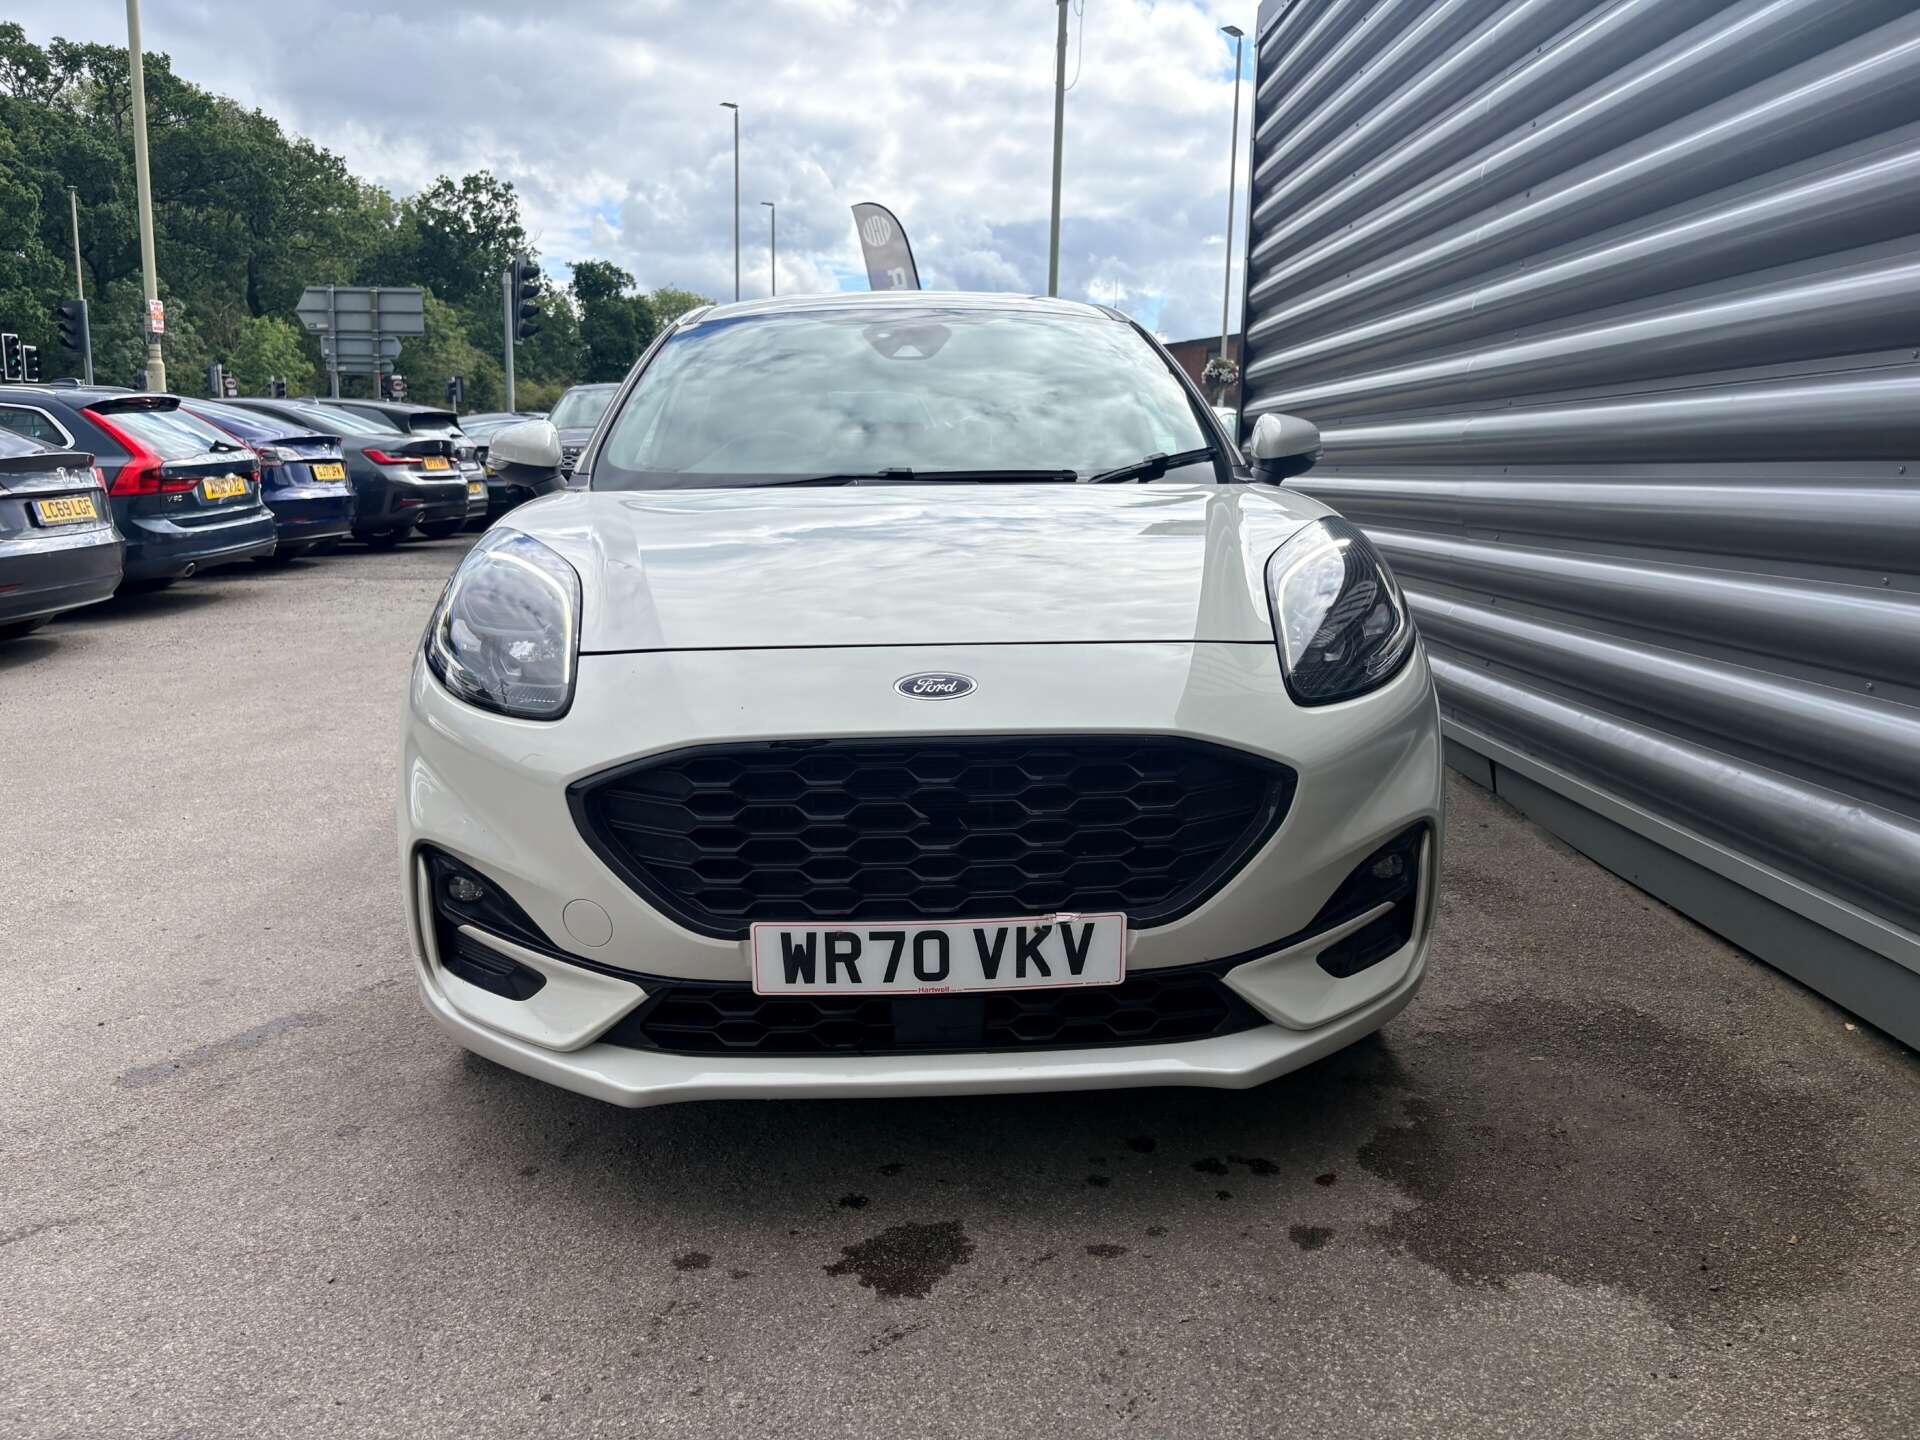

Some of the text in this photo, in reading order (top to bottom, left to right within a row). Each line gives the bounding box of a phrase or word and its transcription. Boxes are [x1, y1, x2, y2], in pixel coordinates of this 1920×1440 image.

[40, 498, 92, 519] LC69 LGF
[913, 678, 958, 693] Ford
[780, 922, 1096, 984] WR70 VKV
